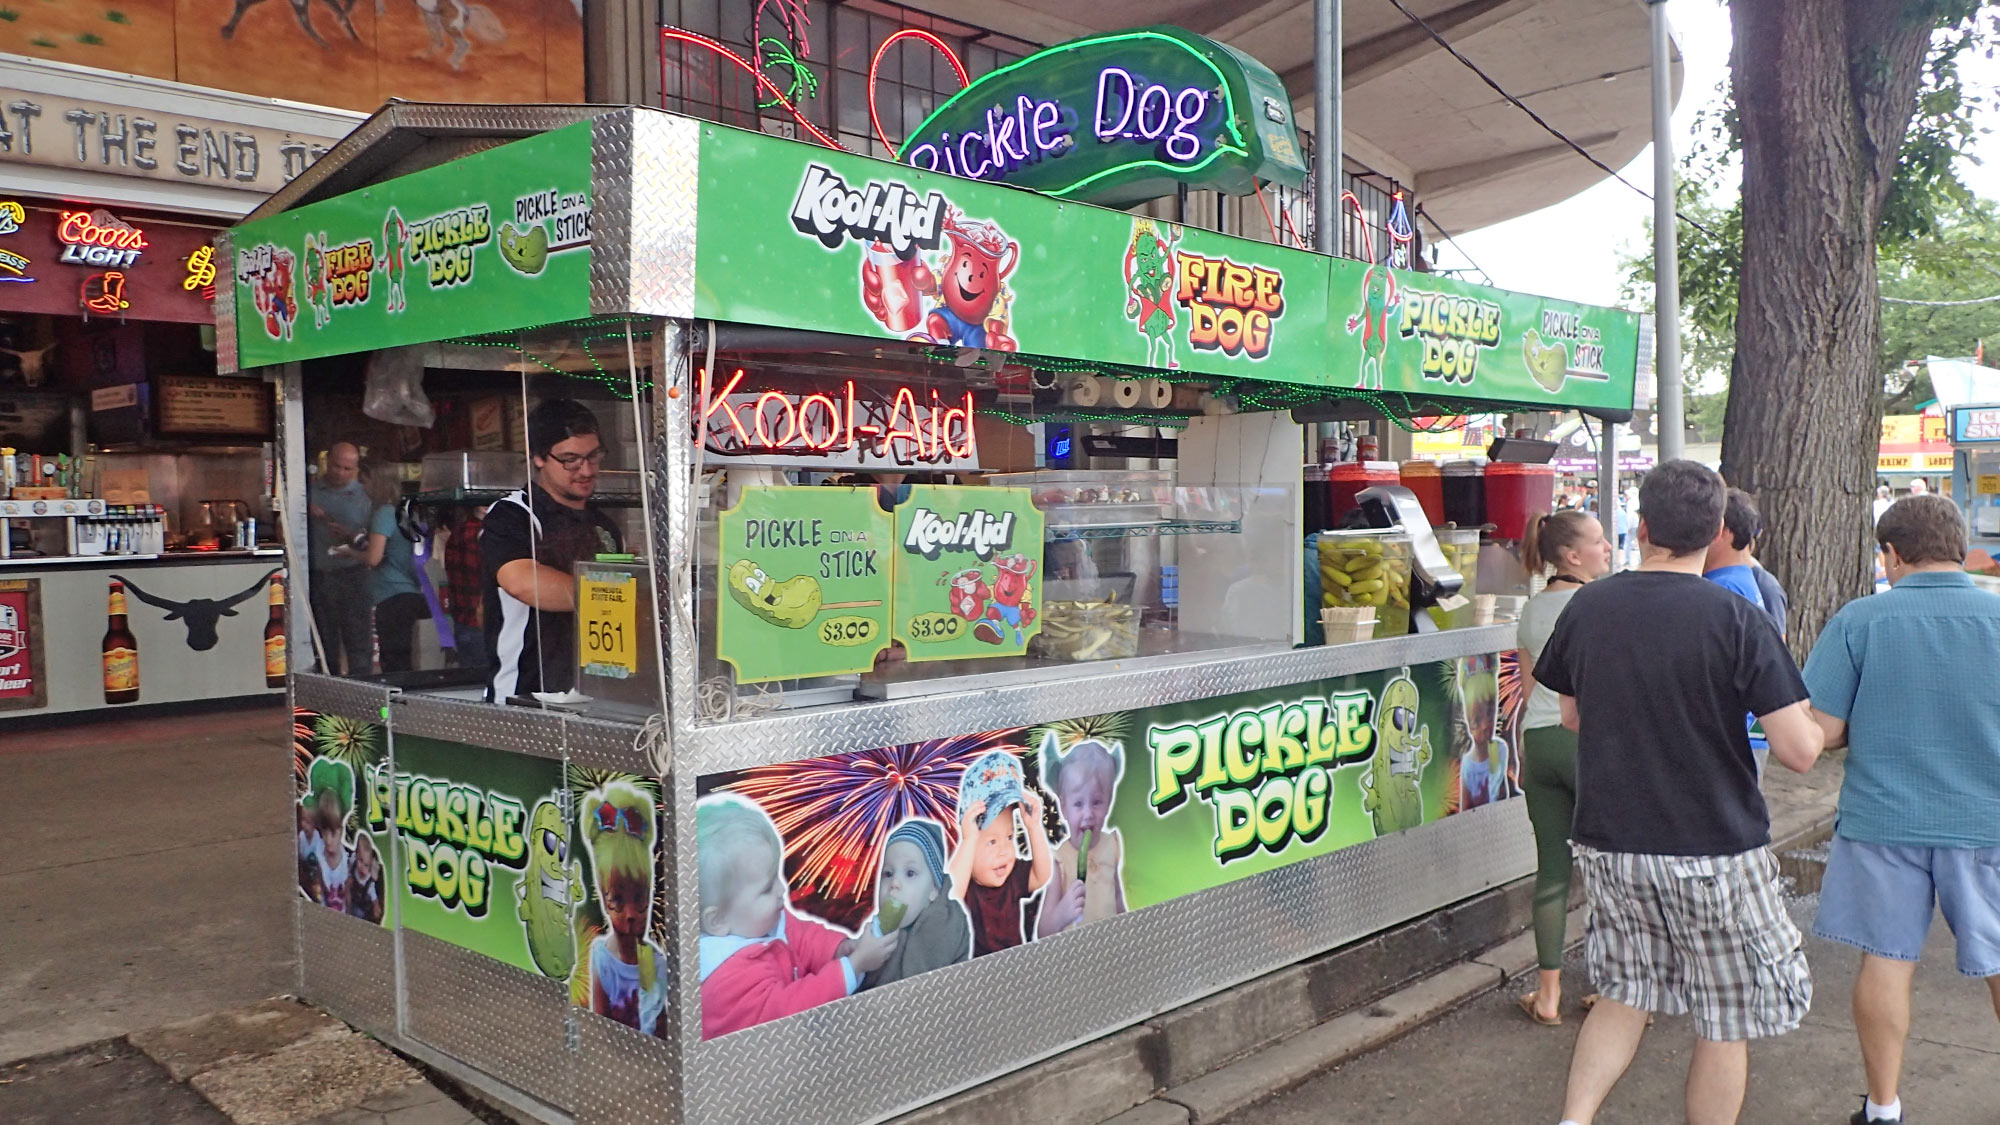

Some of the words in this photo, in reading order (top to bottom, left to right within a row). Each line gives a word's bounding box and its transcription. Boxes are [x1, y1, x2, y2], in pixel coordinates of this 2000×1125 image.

[1095, 68, 1208, 160] Dog
[66, 108, 158, 171] THE
[175, 124, 259, 182] END
[280, 141, 331, 184] O
[58, 210, 149, 249] Coors
[516, 190, 558, 224] PICKLE
[562, 196, 577, 210] ON
[577, 194, 586, 208] A
[556, 209, 592, 242] STICK
[791, 164, 945, 260] Kool-Aid
[409, 205, 491, 262] PICKLE
[60, 245, 143, 269] LIGHT
[324, 240, 374, 283] FIRE
[429, 246, 473, 287] DOG
[331, 271, 370, 306] DOG
[1177, 250, 1285, 318] FIRE
[1189, 299, 1272, 359] DOG
[1399, 288, 1501, 348] PICKLE
[1542, 310, 1579, 339] PICKLE
[1581, 327, 1592, 339] ON
[1592, 329, 1600, 339] A
[1423, 336, 1477, 383] DOG
[1574, 344, 1604, 369] STICK
[694, 368, 974, 459] Kool-Aid
[745, 519, 823, 549] PICKLE
[830, 531, 854, 544] ON
[856, 530, 868, 542] A
[905, 509, 1016, 561] Kool-Aid
[819, 549, 878, 579] STICK
[588, 620, 624, 653] 561
[824, 619, 871, 642] $3.00
[911, 616, 959, 638] $3.00
[1150, 692, 1378, 816] PICKLE
[367, 765, 529, 870] PICKLE
[1213, 764, 1333, 865] DOG
[405, 833, 490, 918] DOG
